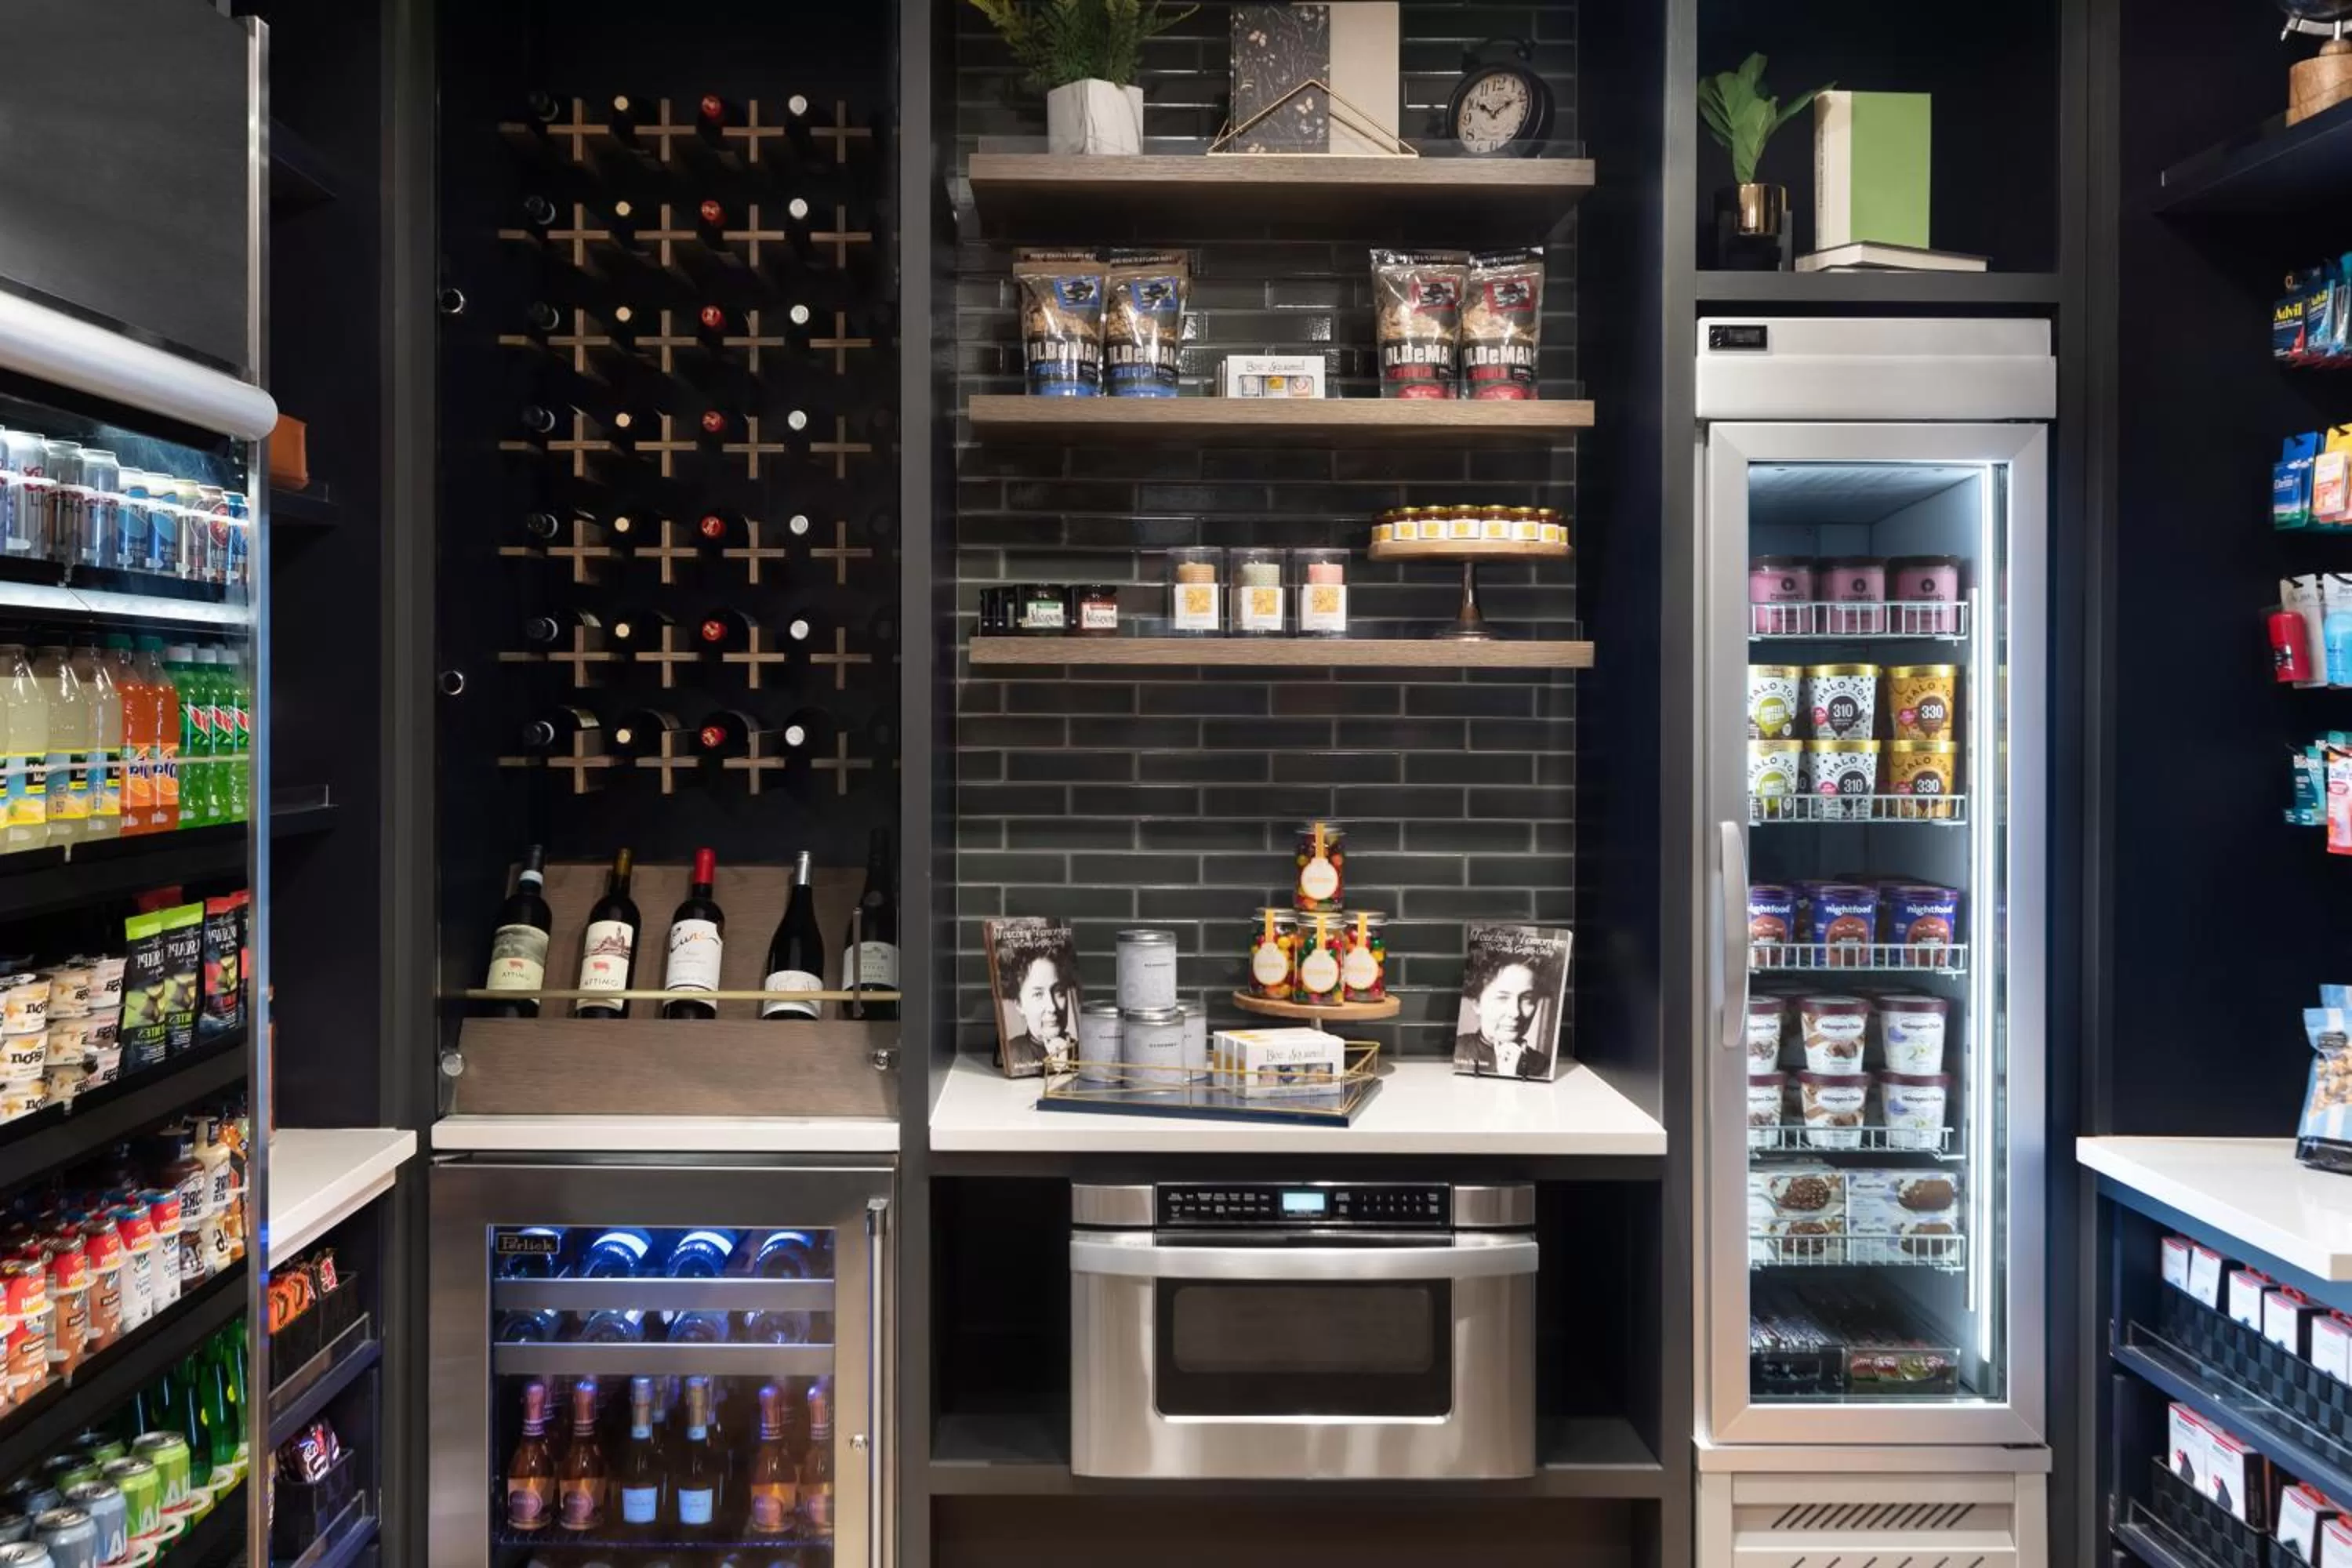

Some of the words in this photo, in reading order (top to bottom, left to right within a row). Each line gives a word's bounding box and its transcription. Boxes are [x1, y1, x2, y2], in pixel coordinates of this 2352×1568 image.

[1462, 112, 1472, 126] 9
[2274, 302, 2303, 321] Advil
[1818, 681, 1846, 703] HALO
[1904, 682, 1936, 704] HALO
[1832, 703, 1853, 718] 310
[1921, 705, 1944, 719] 330
[1826, 756, 1857, 777] HALO
[1843, 779, 1864, 793] 310
[1917, 779, 1939, 793] 330
[1750, 904, 1790, 915] ightfood
[1825, 903, 1873, 916] nightfood
[1907, 902, 1953, 916] nightfood
